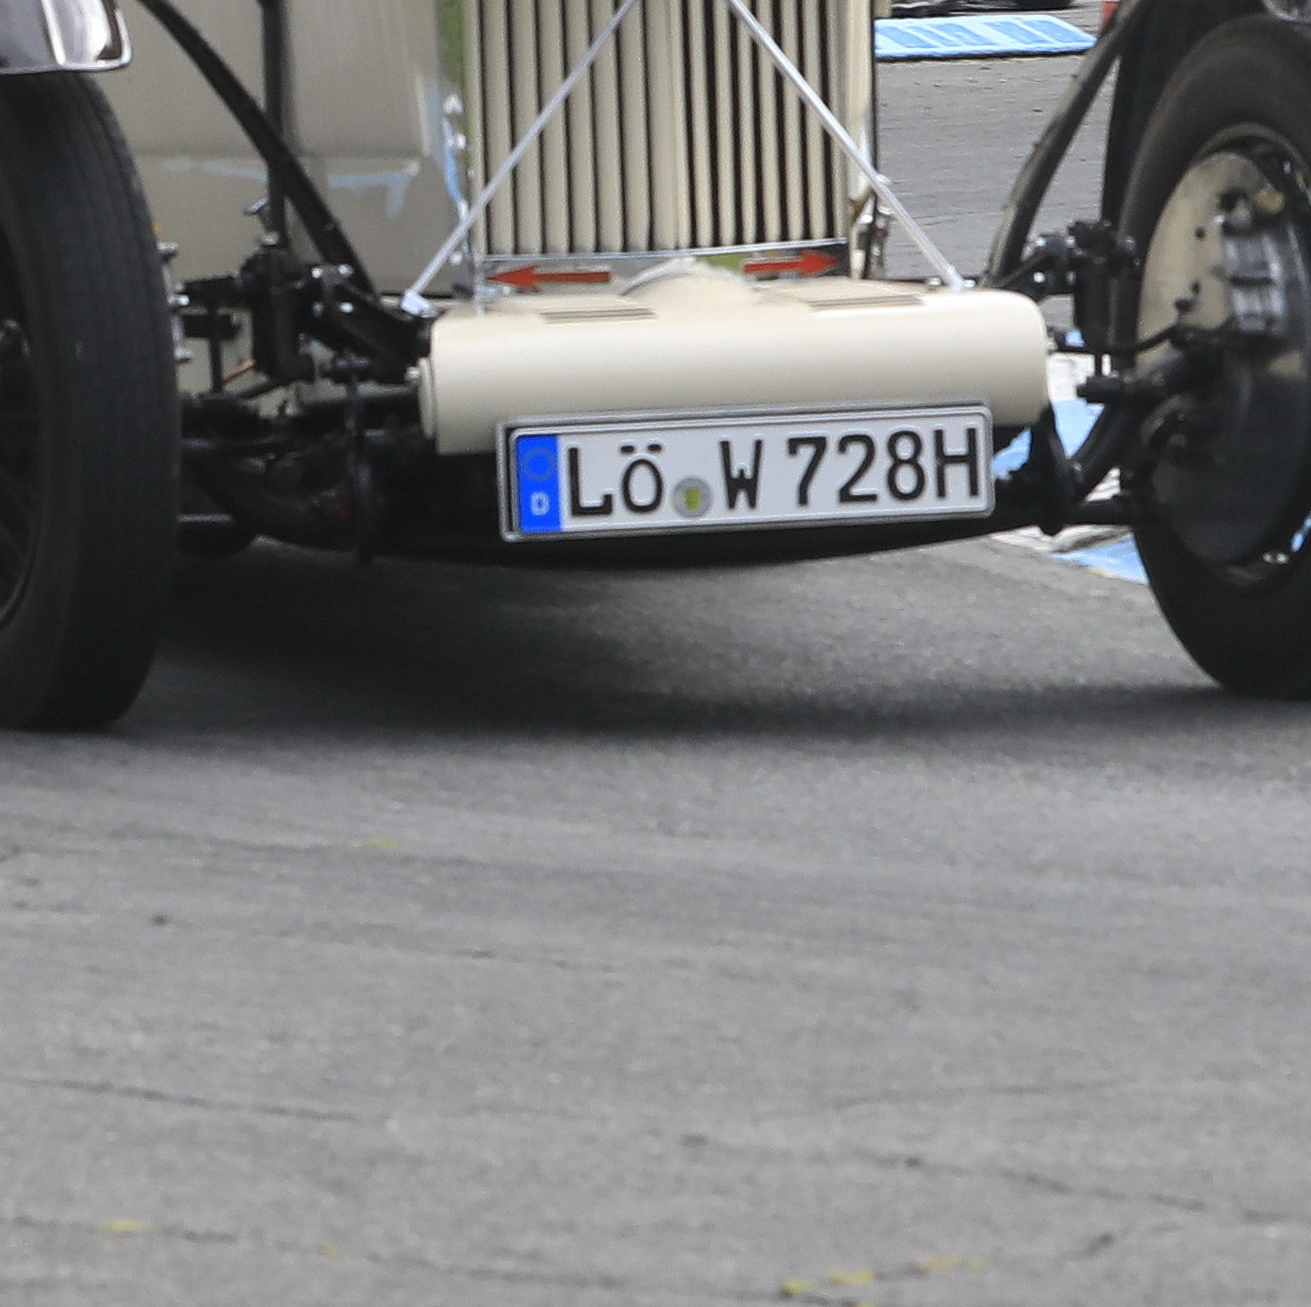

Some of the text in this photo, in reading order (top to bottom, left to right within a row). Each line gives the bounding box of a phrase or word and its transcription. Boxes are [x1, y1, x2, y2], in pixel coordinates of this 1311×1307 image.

[567, 426, 981, 518] LÖ W 728H
